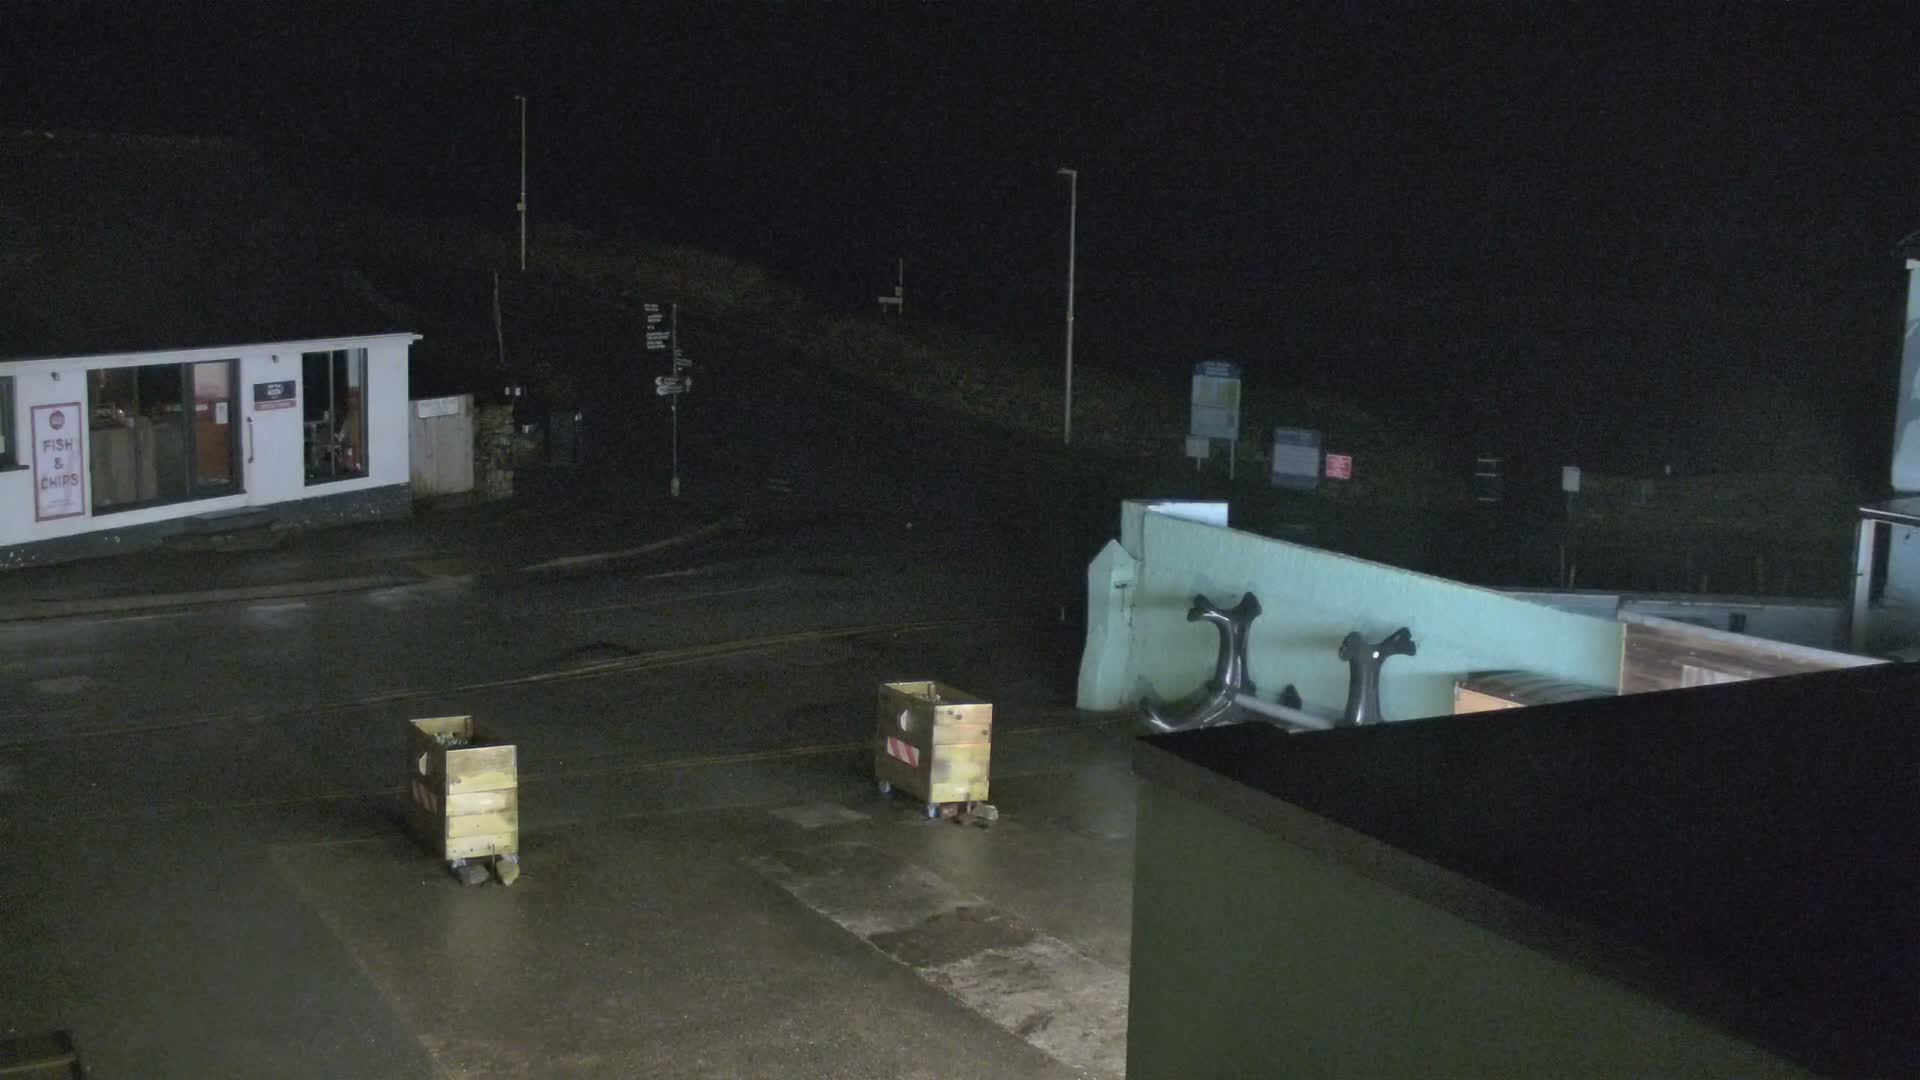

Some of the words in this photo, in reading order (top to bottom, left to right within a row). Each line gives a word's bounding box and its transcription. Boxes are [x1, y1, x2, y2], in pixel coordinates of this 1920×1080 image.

[43, 438, 73, 453] FISH
[54, 457, 64, 470] &
[41, 474, 79, 490] CHIPS
